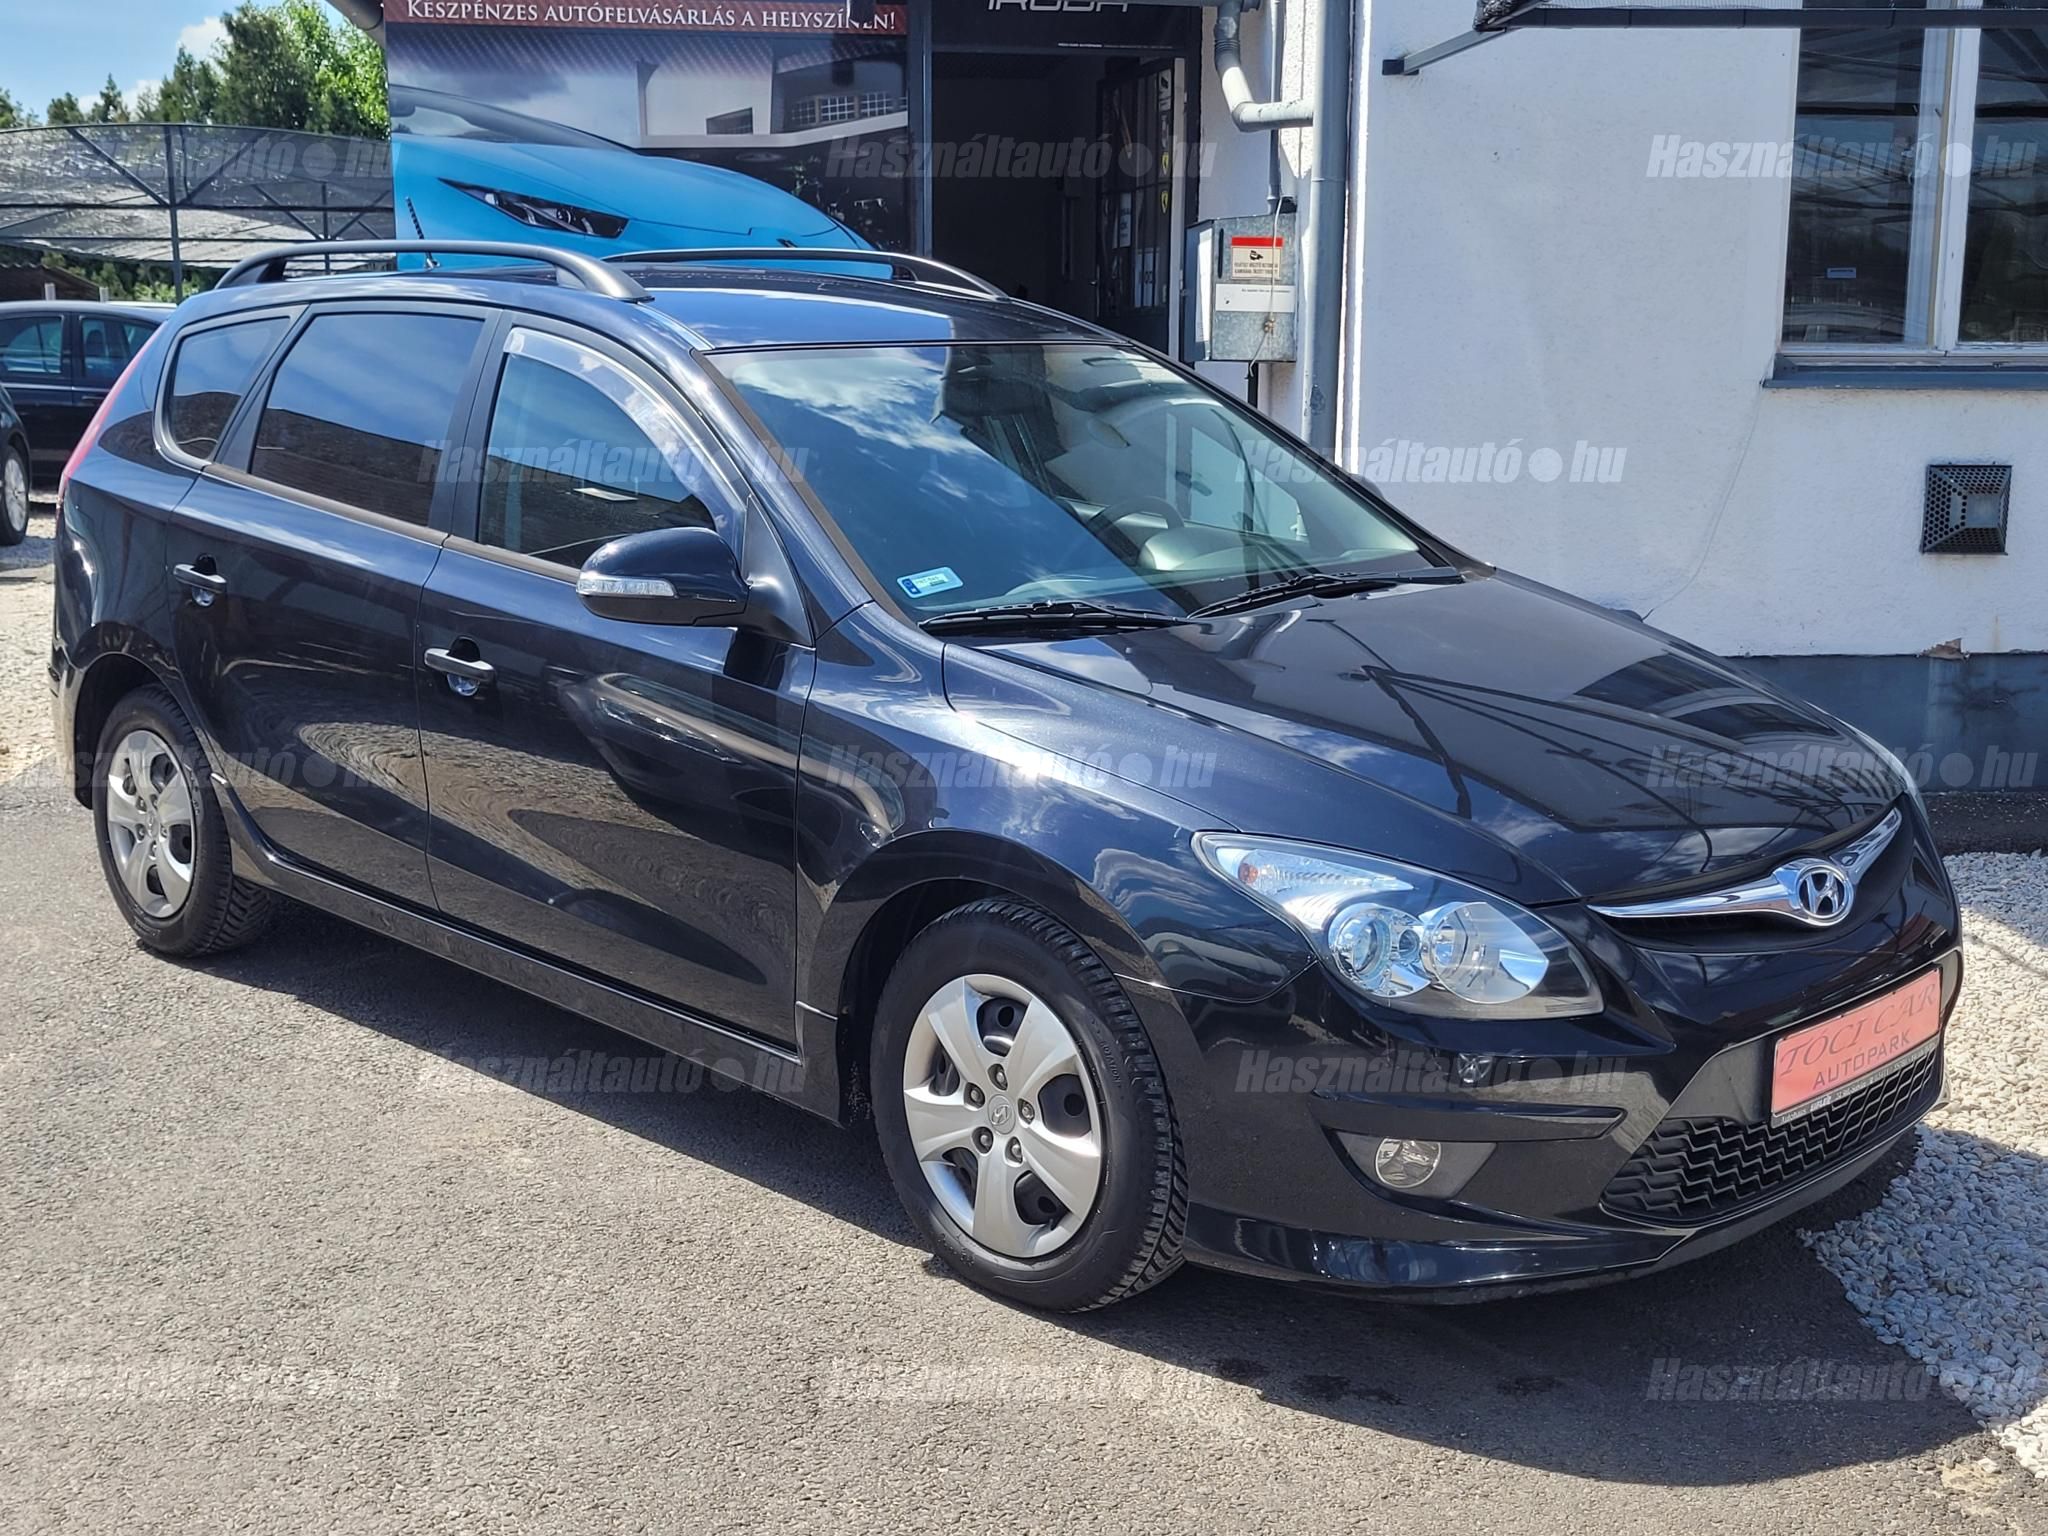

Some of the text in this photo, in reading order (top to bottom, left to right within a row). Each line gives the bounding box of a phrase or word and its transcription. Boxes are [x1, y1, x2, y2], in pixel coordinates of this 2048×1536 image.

[545, 2, 735, 26] AUTÓFELVÁSÁRLÁS
[741, 10, 755, 27] A
[1874, 983, 1936, 1034] CAR
